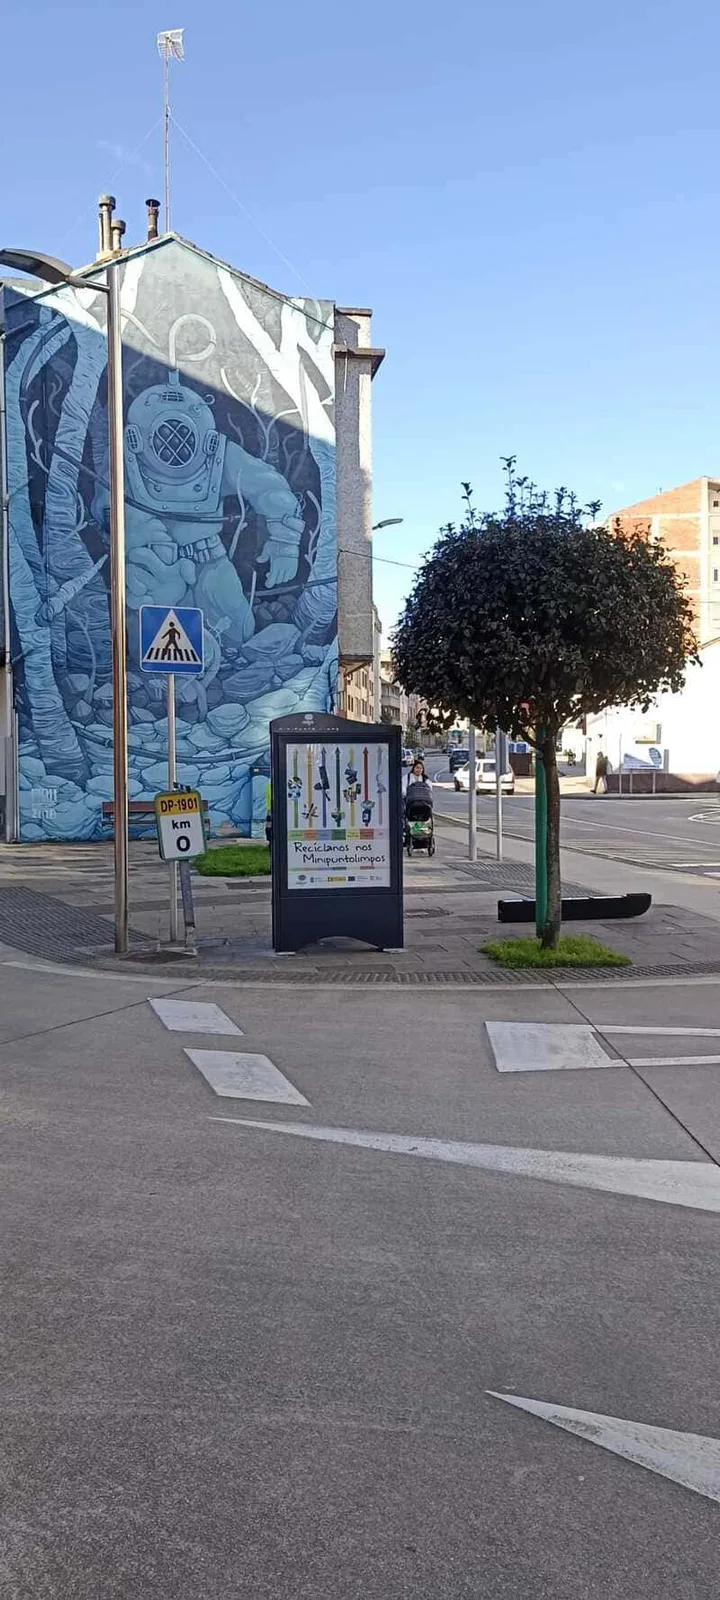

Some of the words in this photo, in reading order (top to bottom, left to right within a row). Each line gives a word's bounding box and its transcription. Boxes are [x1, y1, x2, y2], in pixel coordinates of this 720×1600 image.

[160, 797, 198, 812] DP-1901
[172, 820, 190, 829] km
[176, 836, 190, 851] 0
[303, 853, 385, 867] Minipuntolimpos
